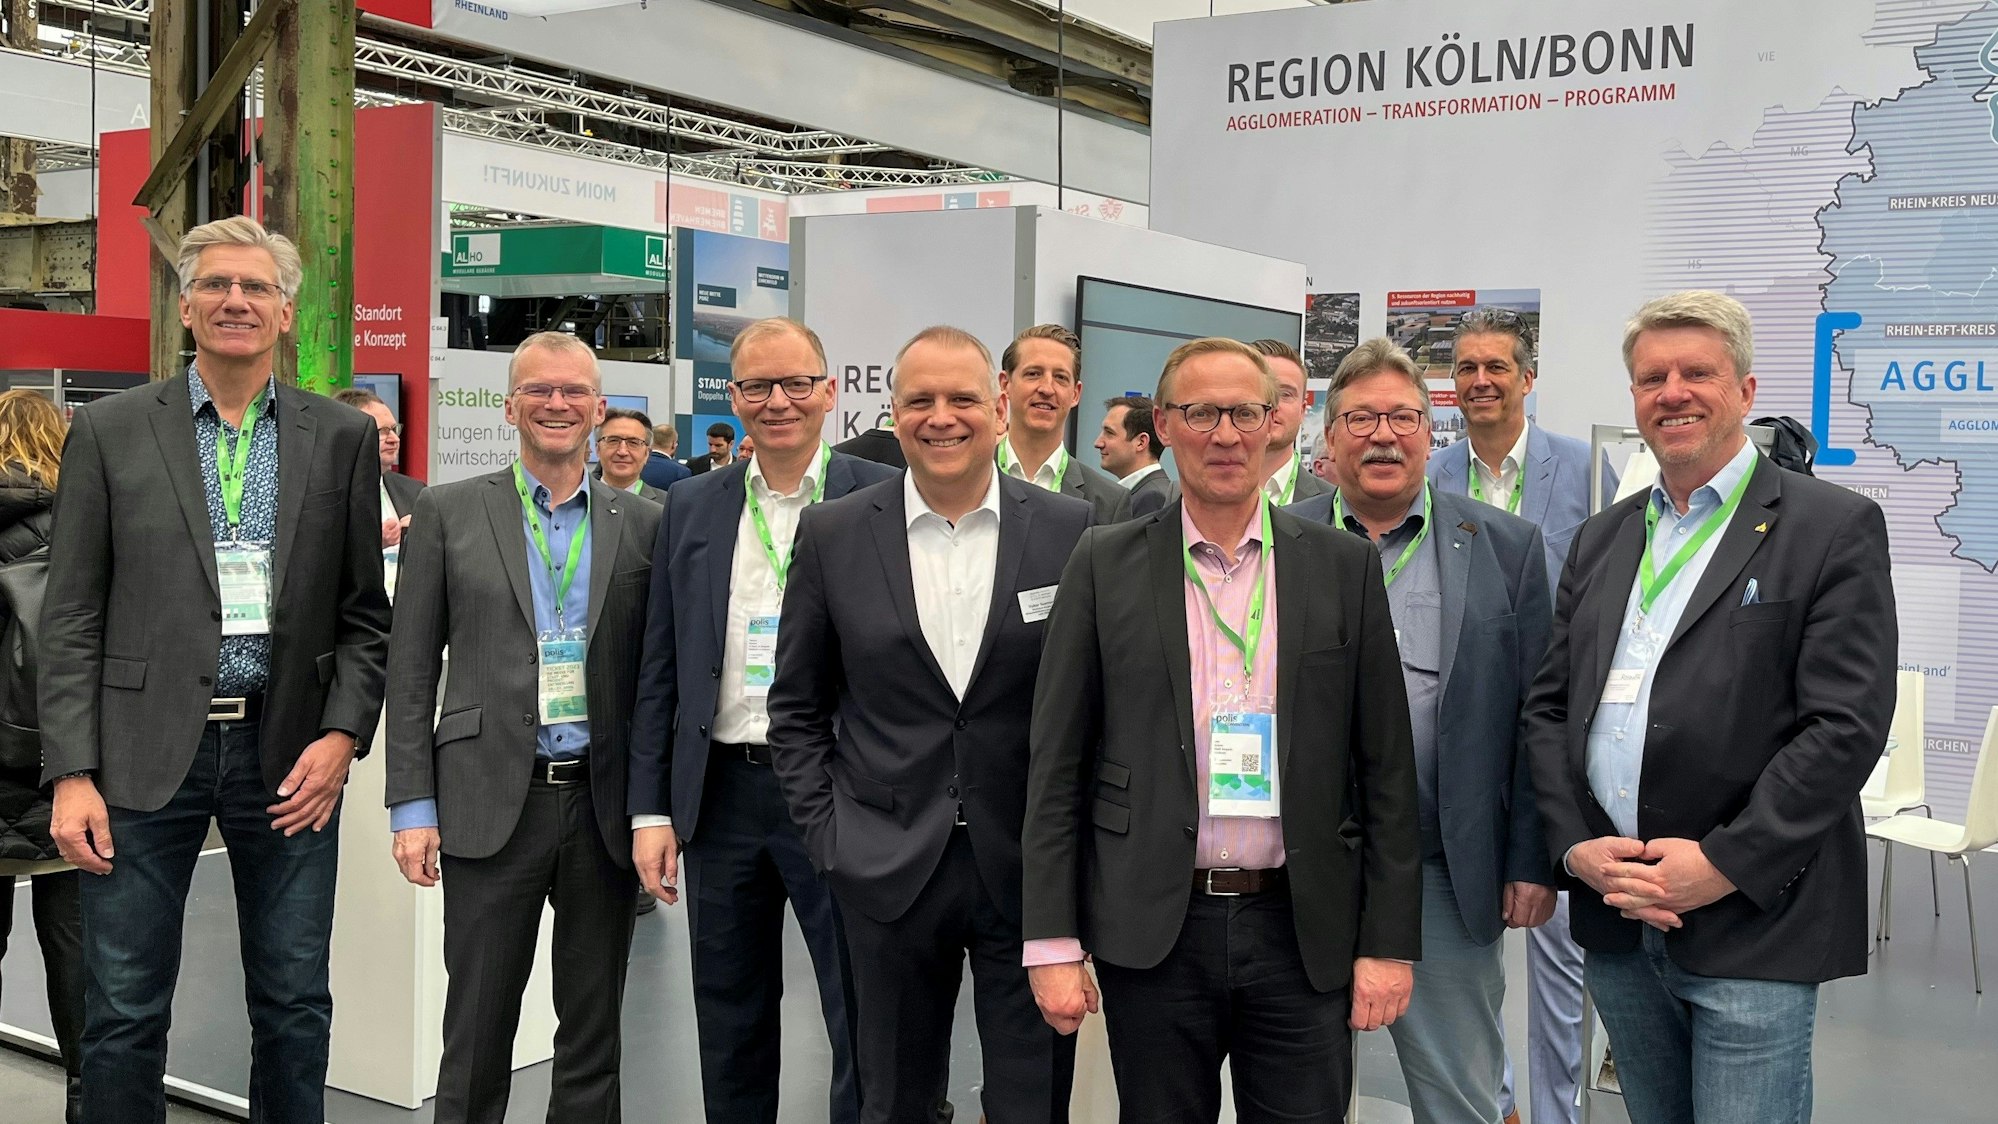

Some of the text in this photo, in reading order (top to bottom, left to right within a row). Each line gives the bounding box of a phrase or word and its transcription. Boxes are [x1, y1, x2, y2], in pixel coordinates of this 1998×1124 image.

[455, 0, 509, 21] RHEINLAND
[1228, 23, 1694, 103] REGION KÖLN/BONN
[1757, 51, 1776, 62] VIE
[1226, 106, 1362, 132] AGGLOMERATION
[1382, 93, 1542, 120] TRANSFORMATION
[1564, 83, 1676, 108] PROGRAMM
[1790, 146, 1809, 157] MG
[1890, 195, 1967, 210] RHEIN-KREIS
[455, 251, 483, 264] ALHO
[1687, 259, 1703, 270] HS
[355, 304, 402, 321] Standort
[1886, 324, 1997, 336] RHEIN-ERFT-KREIS
[363, 330, 407, 350] Konzept
[1880, 360, 1994, 391] AGGL
[497, 424, 518, 441] für
[544, 648, 564, 658] polis
[1215, 713, 1238, 724] polis
